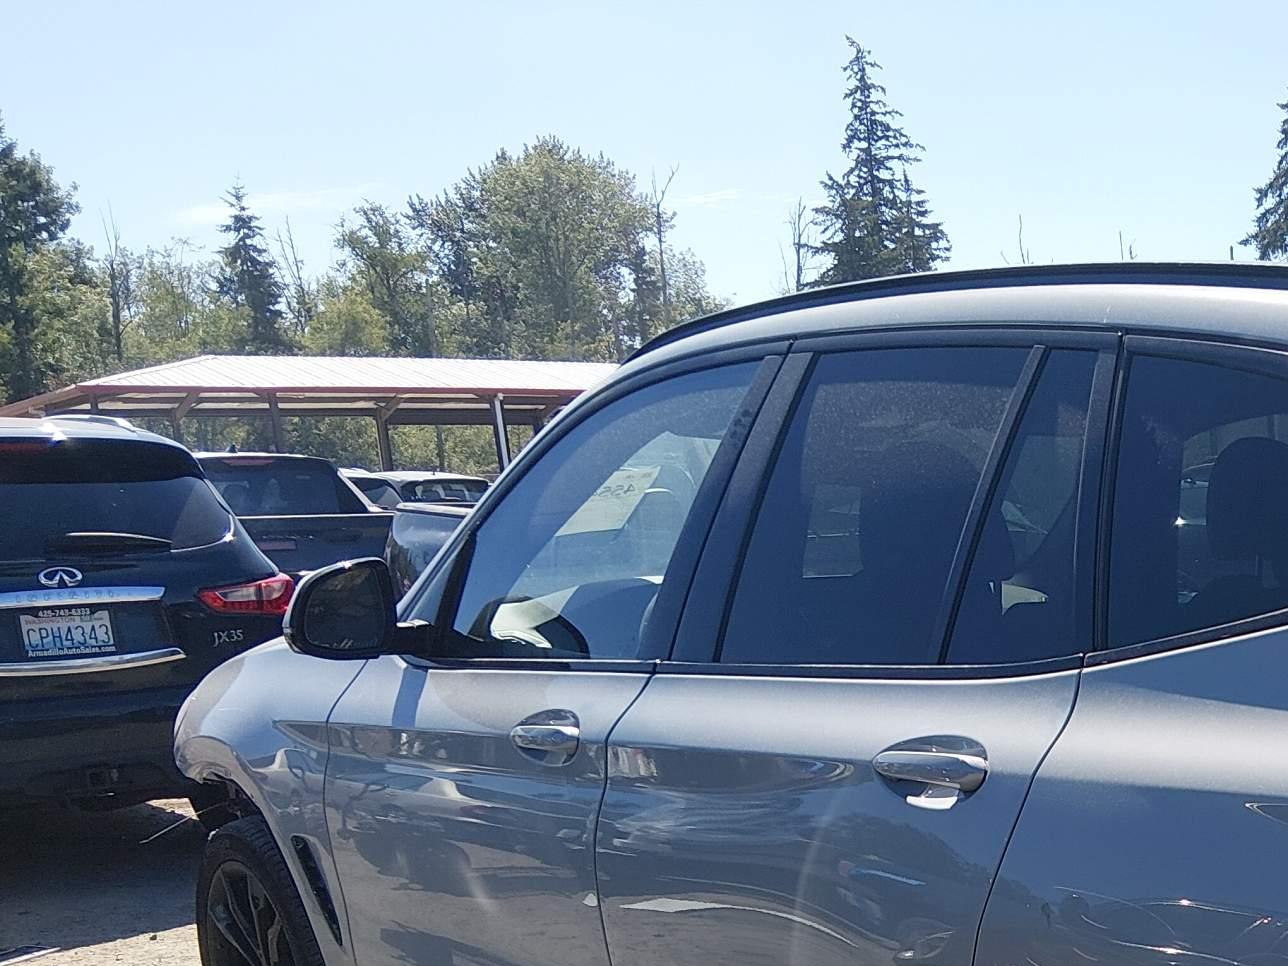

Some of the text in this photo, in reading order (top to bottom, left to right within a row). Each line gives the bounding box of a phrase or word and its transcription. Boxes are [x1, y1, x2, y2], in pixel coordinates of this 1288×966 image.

[26, 623, 111, 649] CPH4343
[213, 629, 244, 648] JX35
[28, 645, 117, 657] ArmadilloAutoSales.com
